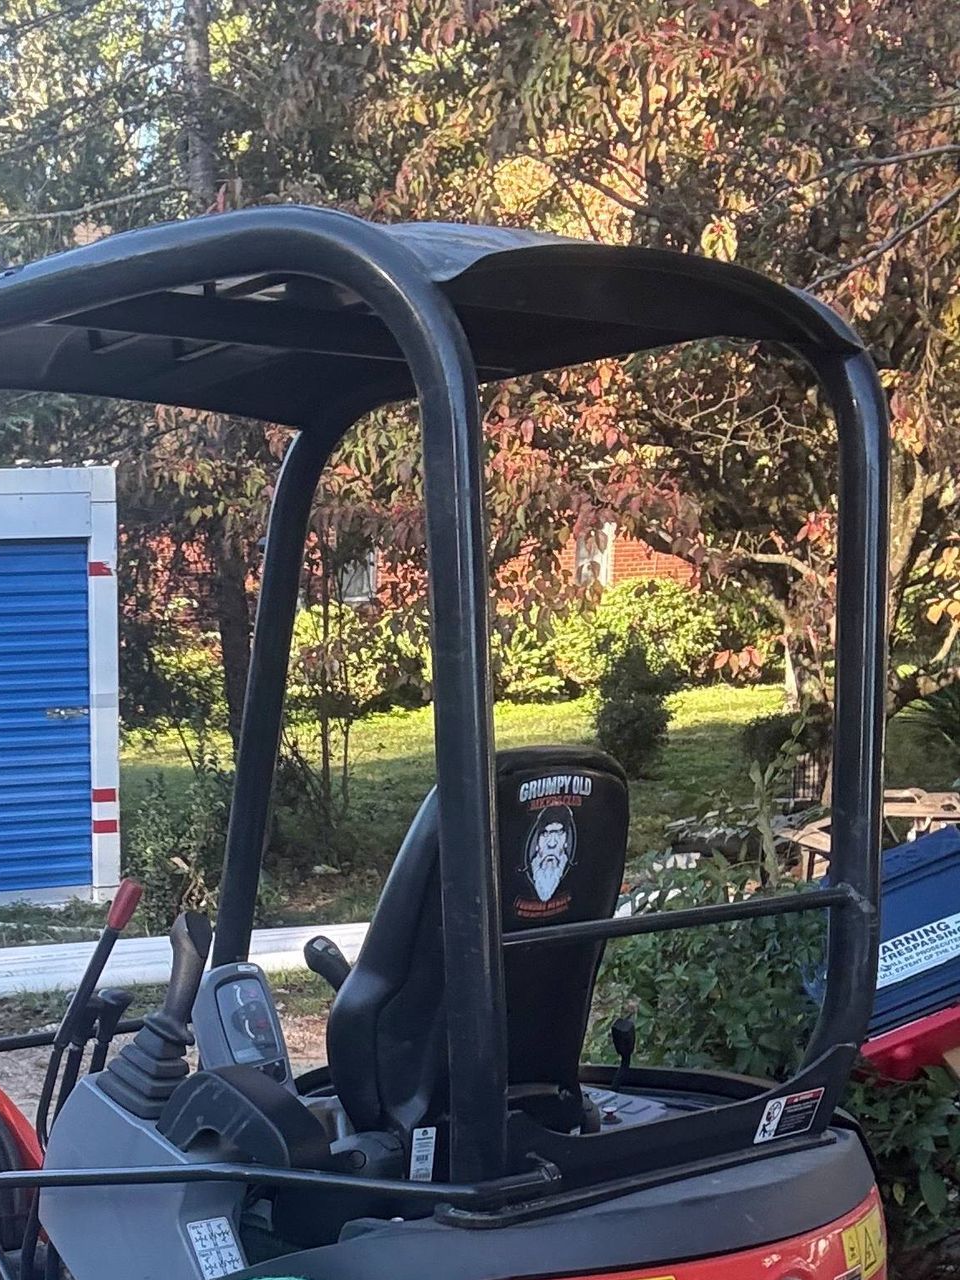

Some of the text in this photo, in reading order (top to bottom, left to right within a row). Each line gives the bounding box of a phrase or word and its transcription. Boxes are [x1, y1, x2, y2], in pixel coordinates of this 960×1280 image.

[519, 775, 592, 802] GRUMPY OLD
[881, 921, 951, 956] ARNING
[904, 954, 915, 962] BE
[915, 936, 960, 957] PROSECUTE
[895, 958, 922, 973] EXTENT
[923, 953, 934, 961] OF
[934, 948, 950, 957] THE
